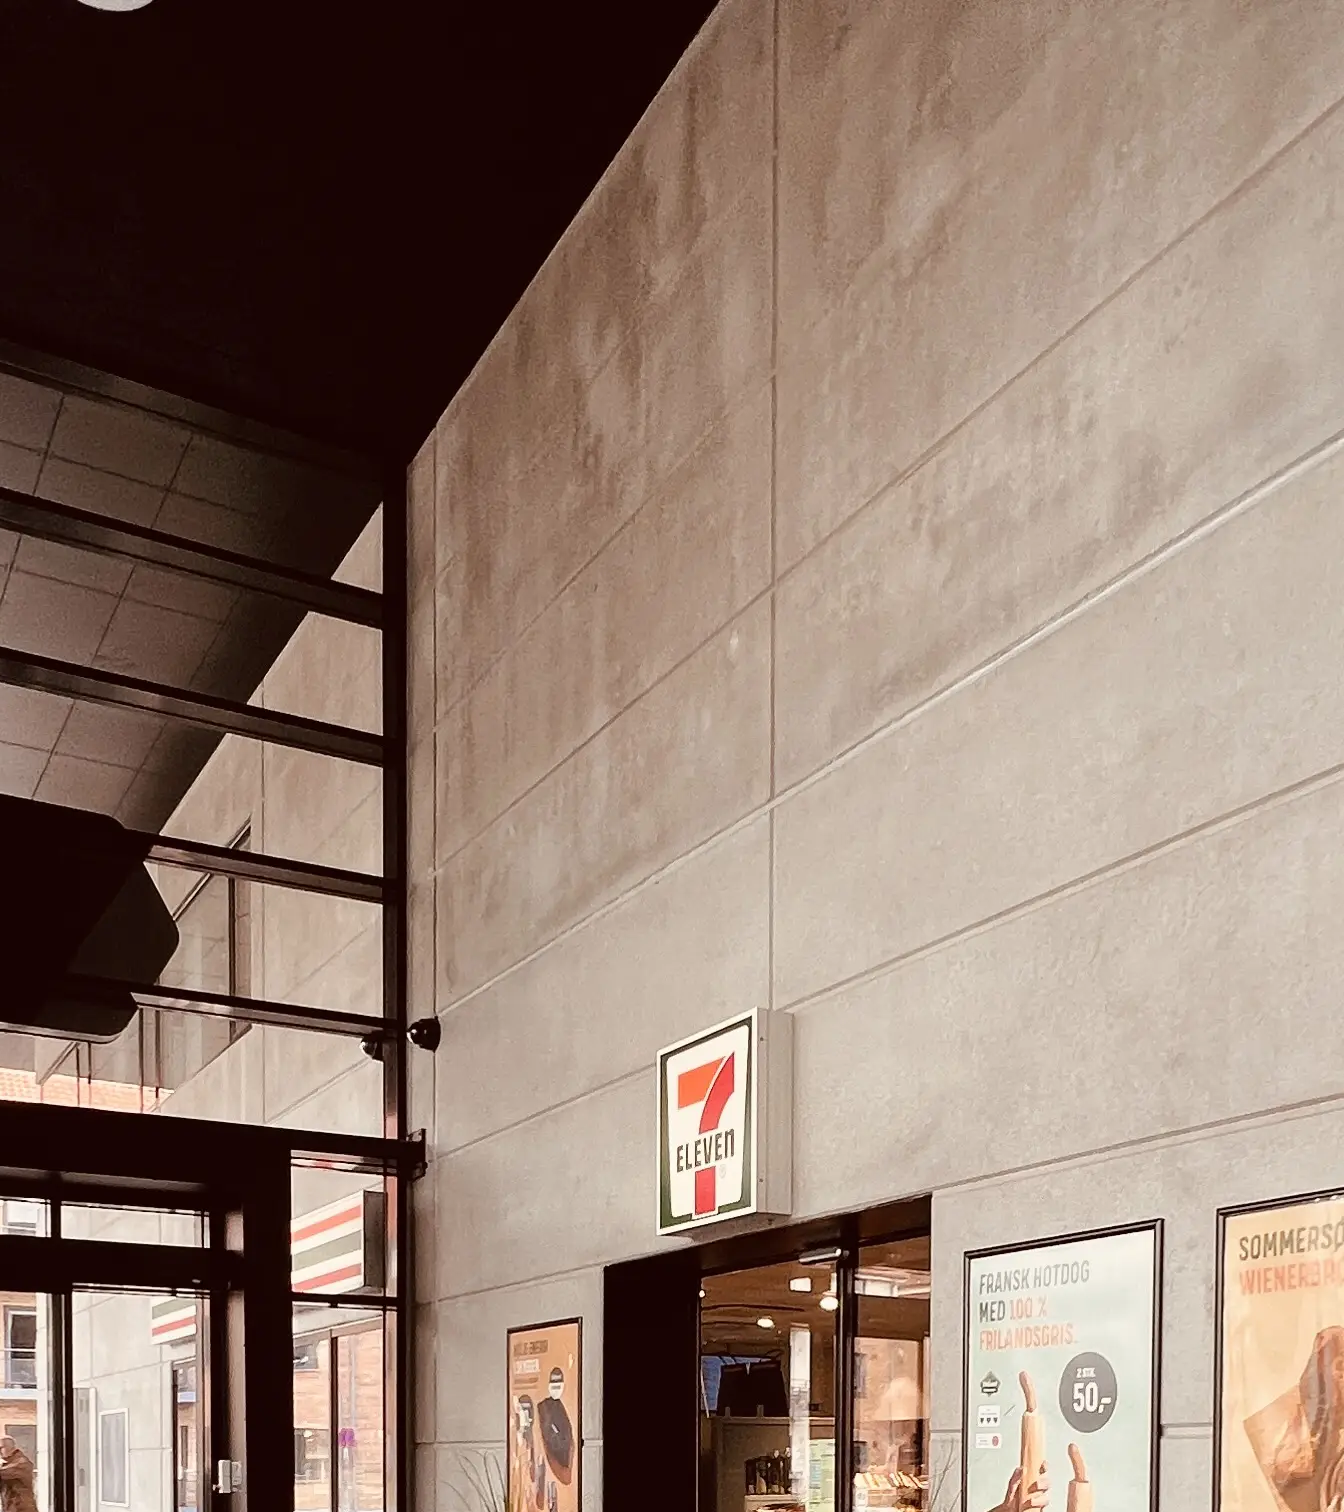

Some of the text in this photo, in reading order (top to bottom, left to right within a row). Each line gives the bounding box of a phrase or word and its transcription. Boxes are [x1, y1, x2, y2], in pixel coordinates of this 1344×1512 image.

[677, 1051, 735, 1216] 7
[979, 1259, 1091, 1296] FRANSK HOTDOG
[979, 1300, 1006, 1324] MED
[1009, 1296, 1034, 1321] 100
